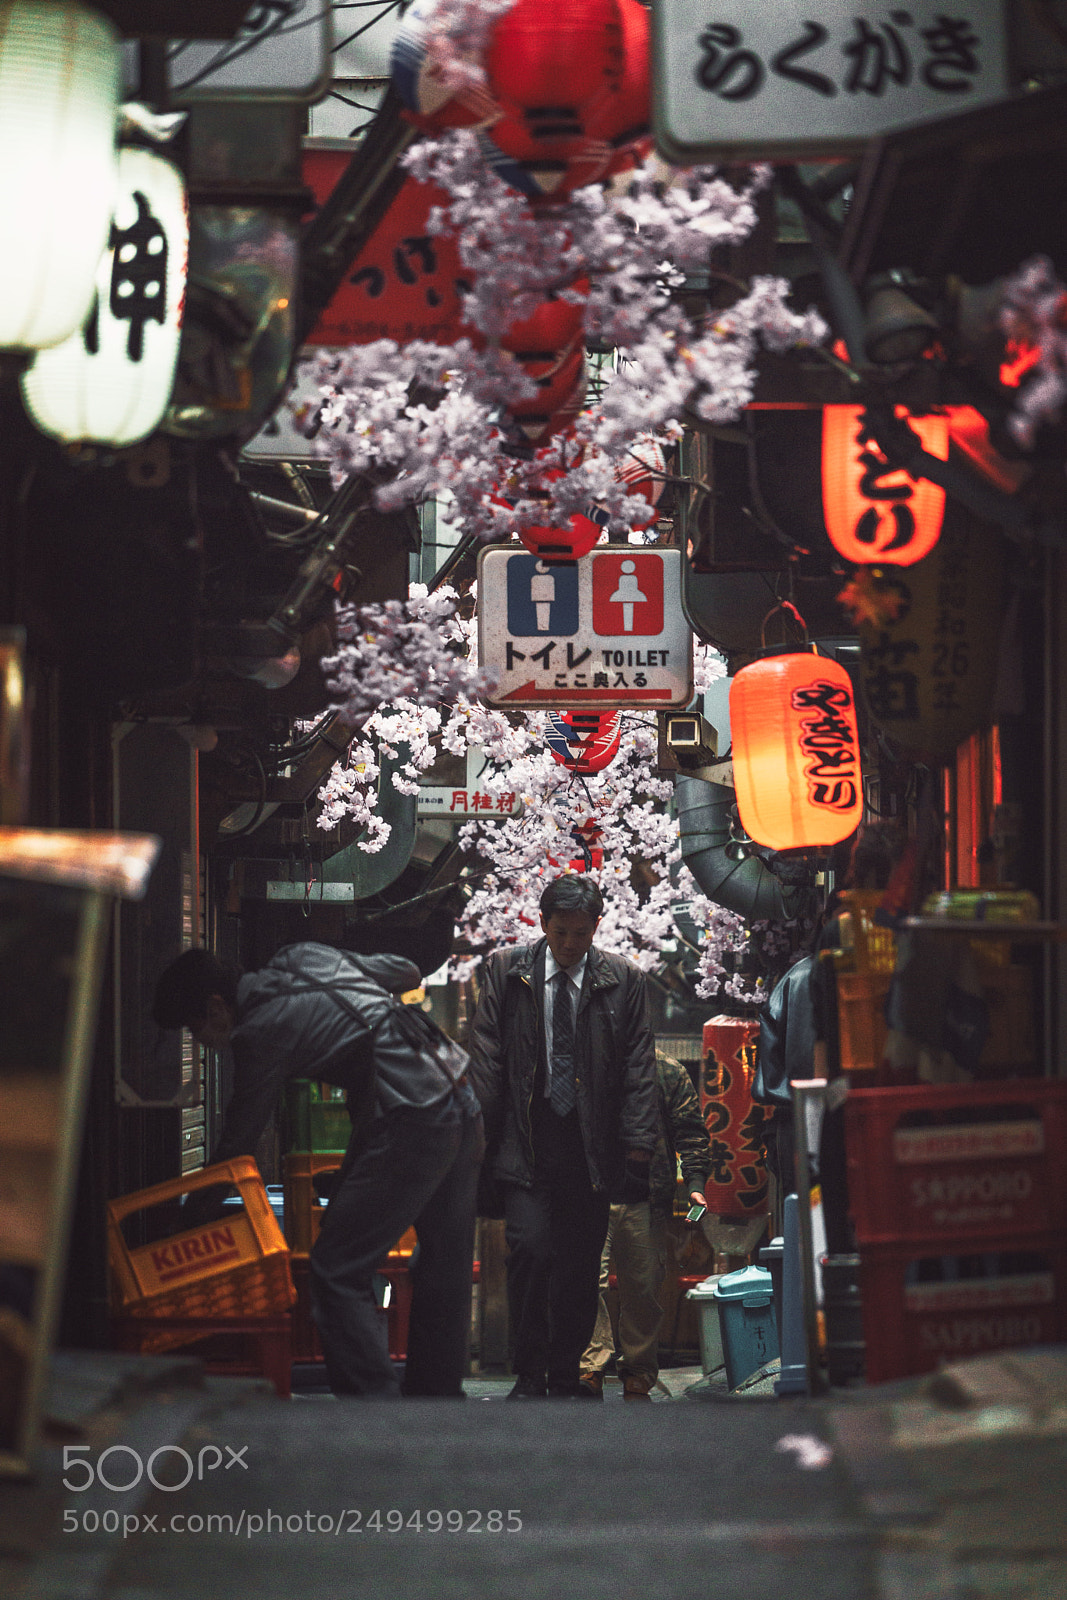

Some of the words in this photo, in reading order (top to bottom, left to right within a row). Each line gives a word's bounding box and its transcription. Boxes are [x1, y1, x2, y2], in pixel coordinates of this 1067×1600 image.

[697, 11, 979, 101] らくがき
[506, 641, 592, 671] トイレ
[602, 650, 669, 667] TOILET
[554, 673, 648, 688] ここ奥入る
[911, 1170, 1032, 1207] SAPPORO
[152, 1225, 236, 1272] KIRIN
